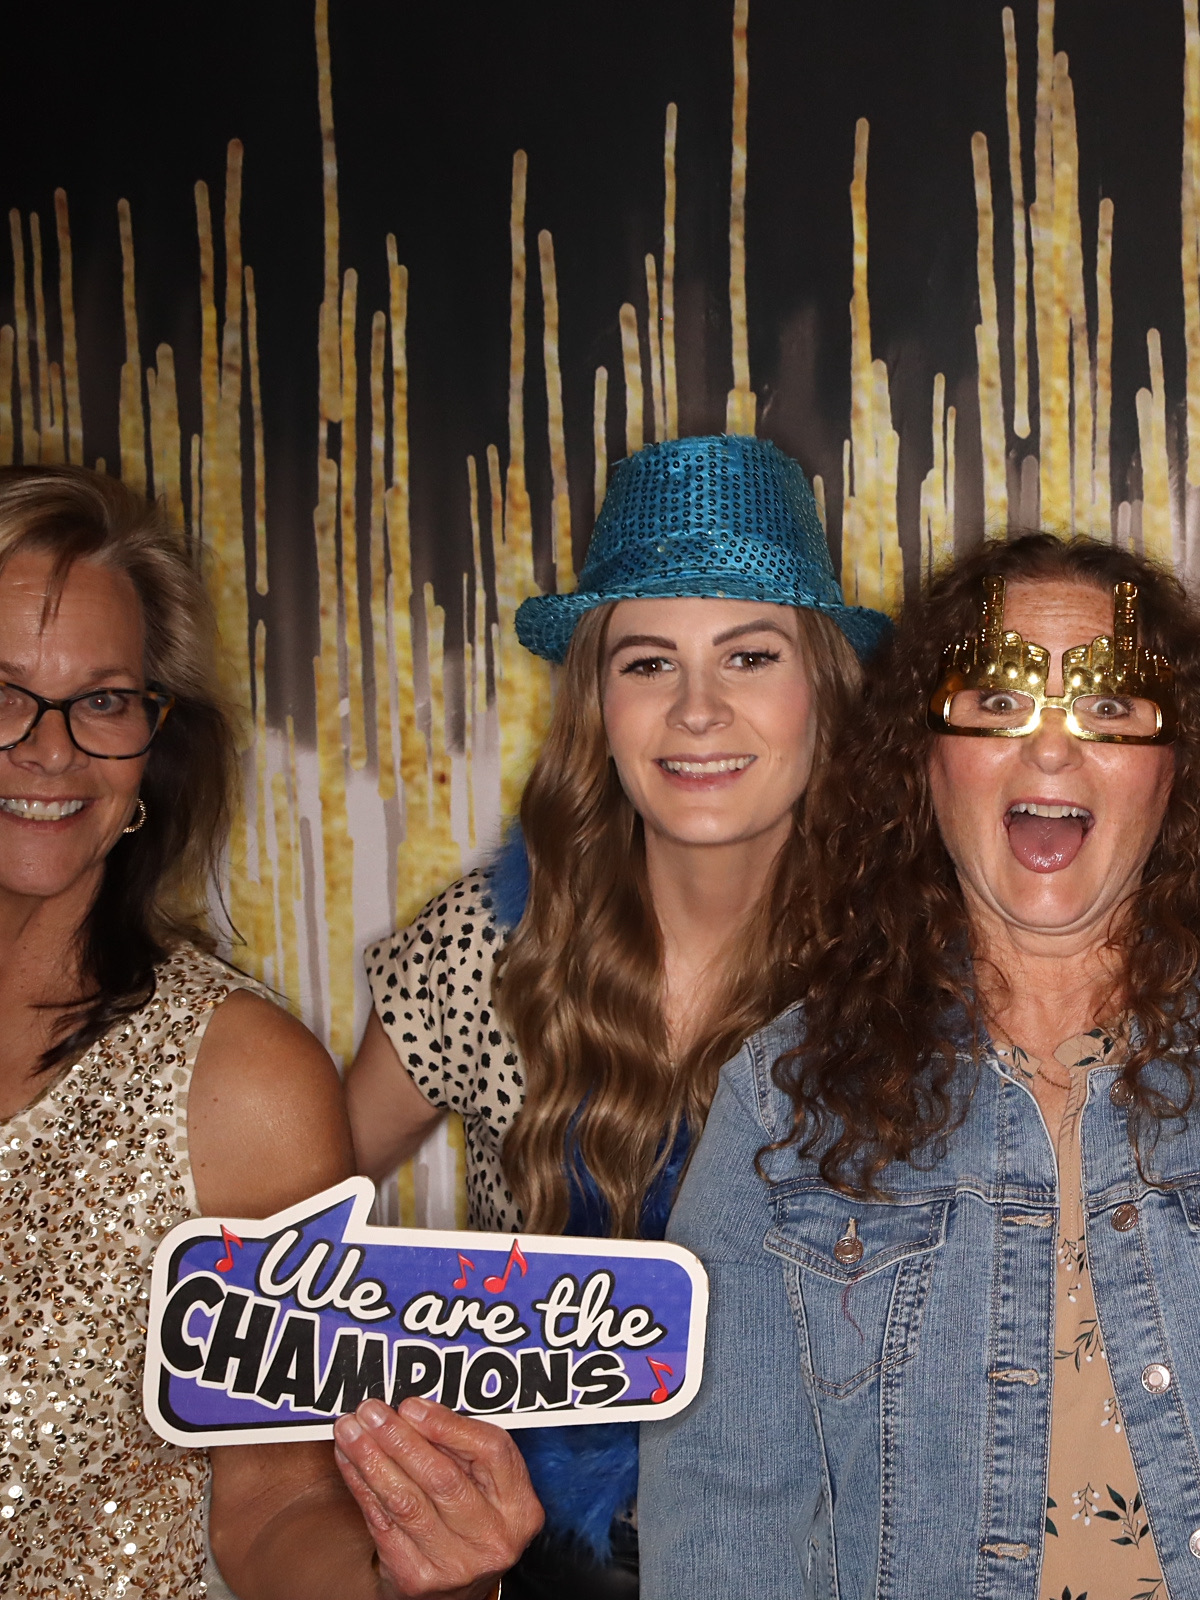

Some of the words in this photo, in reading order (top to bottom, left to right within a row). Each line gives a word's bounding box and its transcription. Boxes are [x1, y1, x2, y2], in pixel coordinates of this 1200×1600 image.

[159, 1276, 629, 1413] CHAMPIONS
[257, 1229, 391, 1320] We
[403, 1292, 528, 1344] are
[535, 1270, 665, 1350] the
